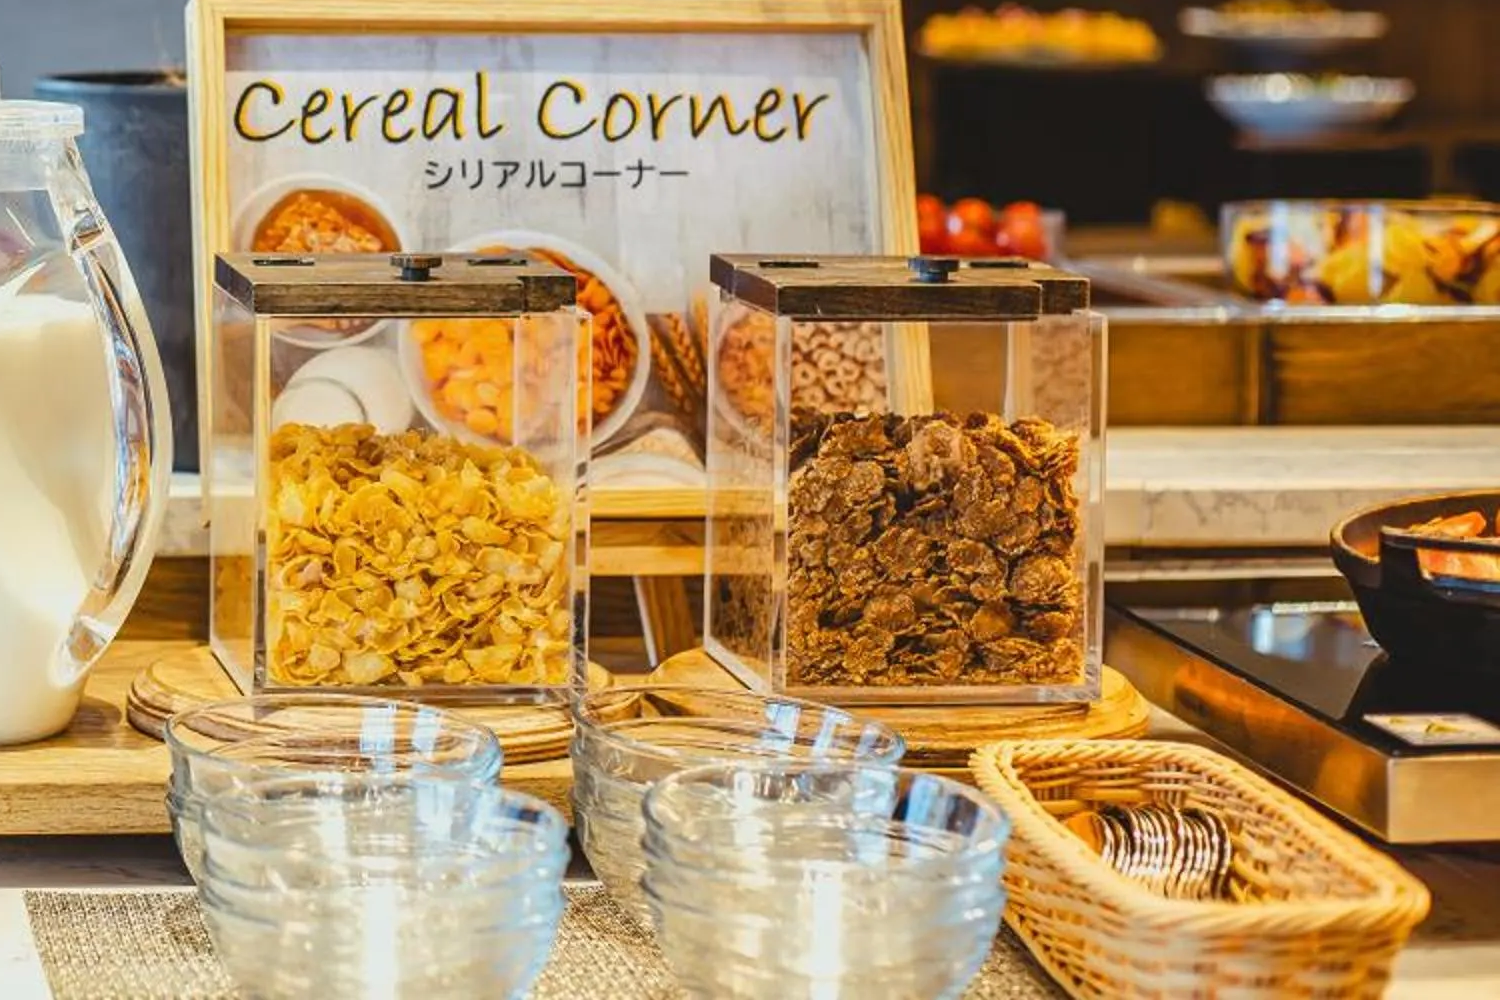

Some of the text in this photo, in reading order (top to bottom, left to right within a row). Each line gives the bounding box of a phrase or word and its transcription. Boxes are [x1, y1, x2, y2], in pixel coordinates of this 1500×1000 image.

[232, 70, 830, 142] Cereal Corner
[424, 159, 690, 190] シリアルコーナー
